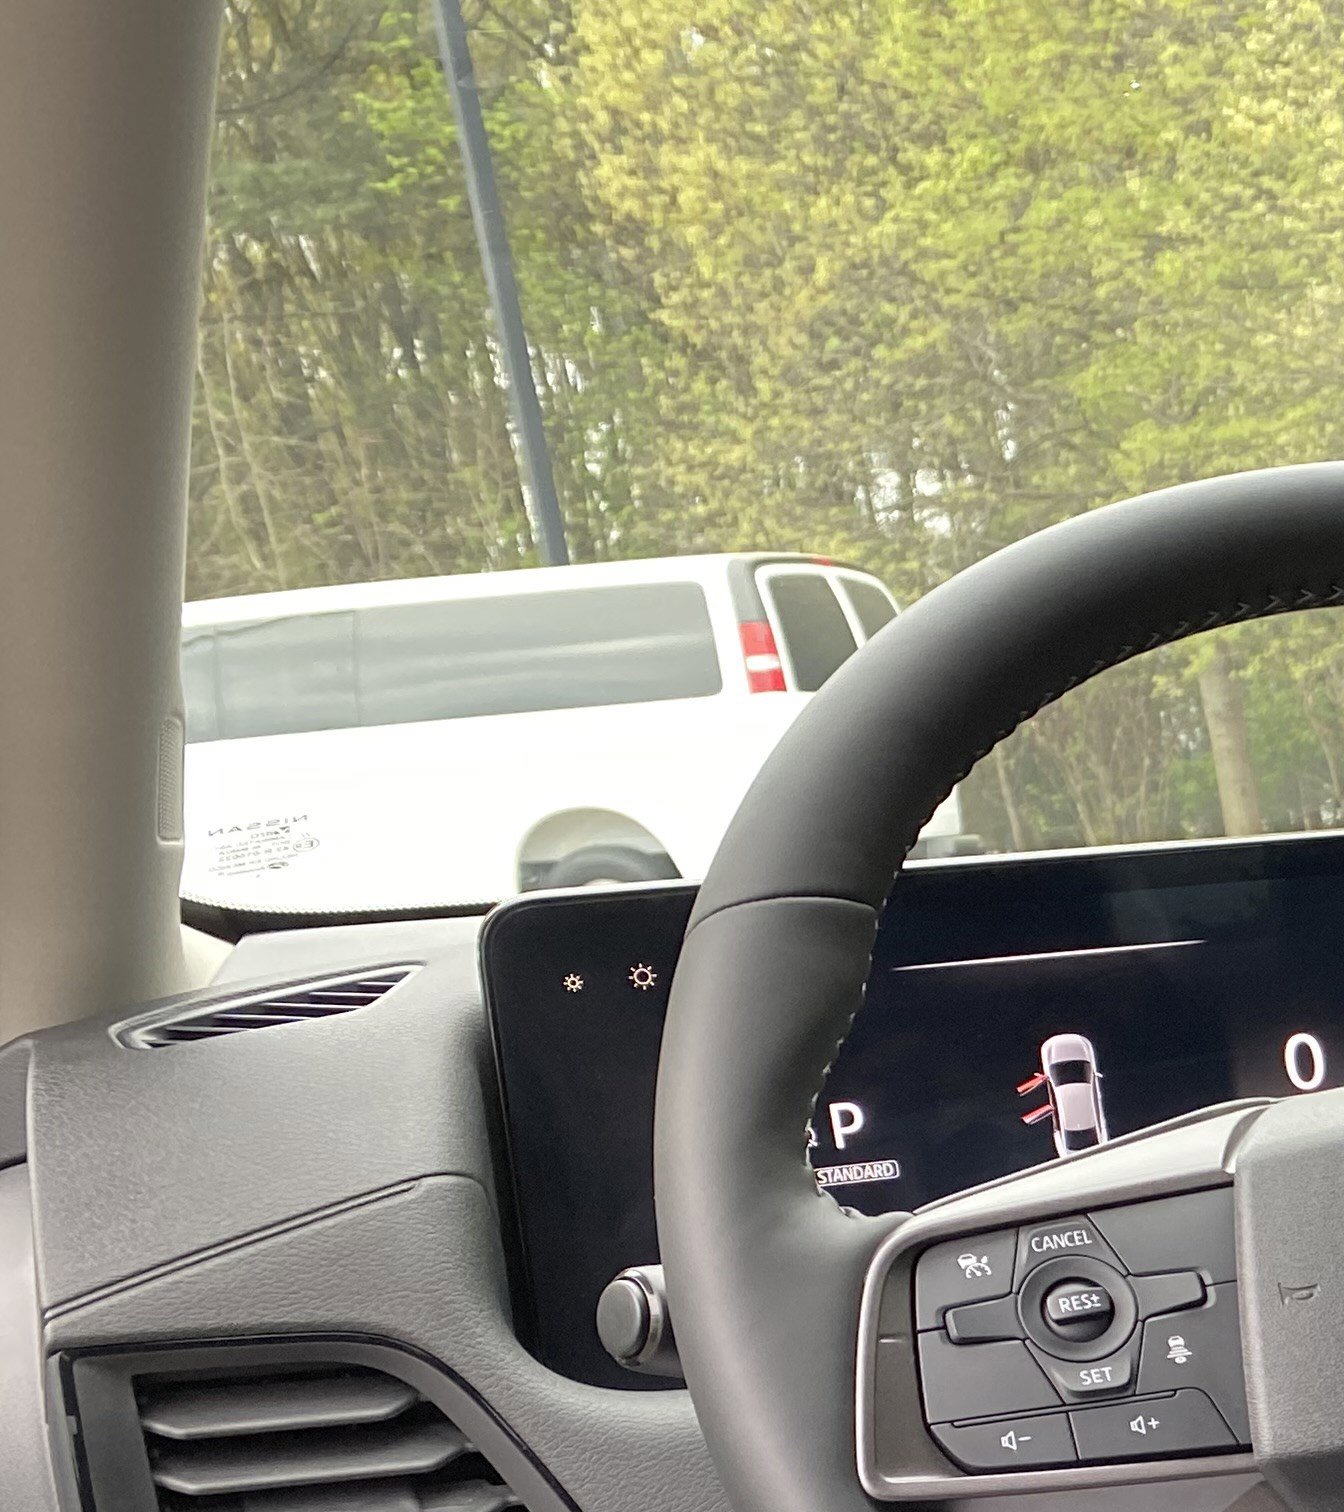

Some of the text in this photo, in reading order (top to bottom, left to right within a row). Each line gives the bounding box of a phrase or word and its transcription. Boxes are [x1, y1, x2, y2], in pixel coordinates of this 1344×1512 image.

[1284, 1032, 1326, 1091] 0
[828, 1102, 864, 1150] P
[816, 1161, 896, 1185] STANDARD
[1031, 1229, 1093, 1253] CANCEL
[1079, 1366, 1113, 1386] SET
